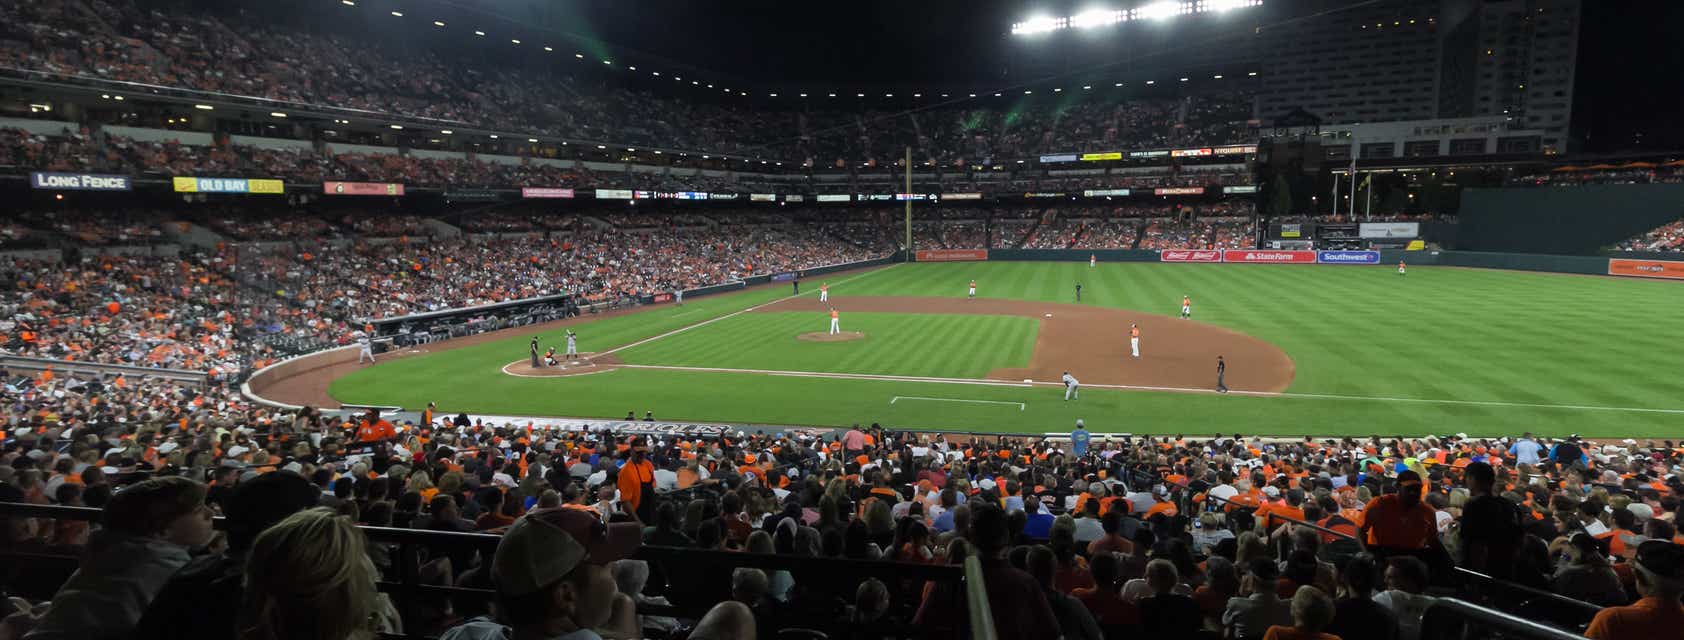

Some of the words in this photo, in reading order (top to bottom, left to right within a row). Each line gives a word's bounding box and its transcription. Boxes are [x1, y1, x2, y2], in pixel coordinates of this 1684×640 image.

[37, 173, 80, 188] LONG
[81, 175, 126, 189] FENCE
[200, 179, 223, 191] OLD
[224, 180, 246, 192] BAY
[1324, 253, 1368, 261] Southwest
